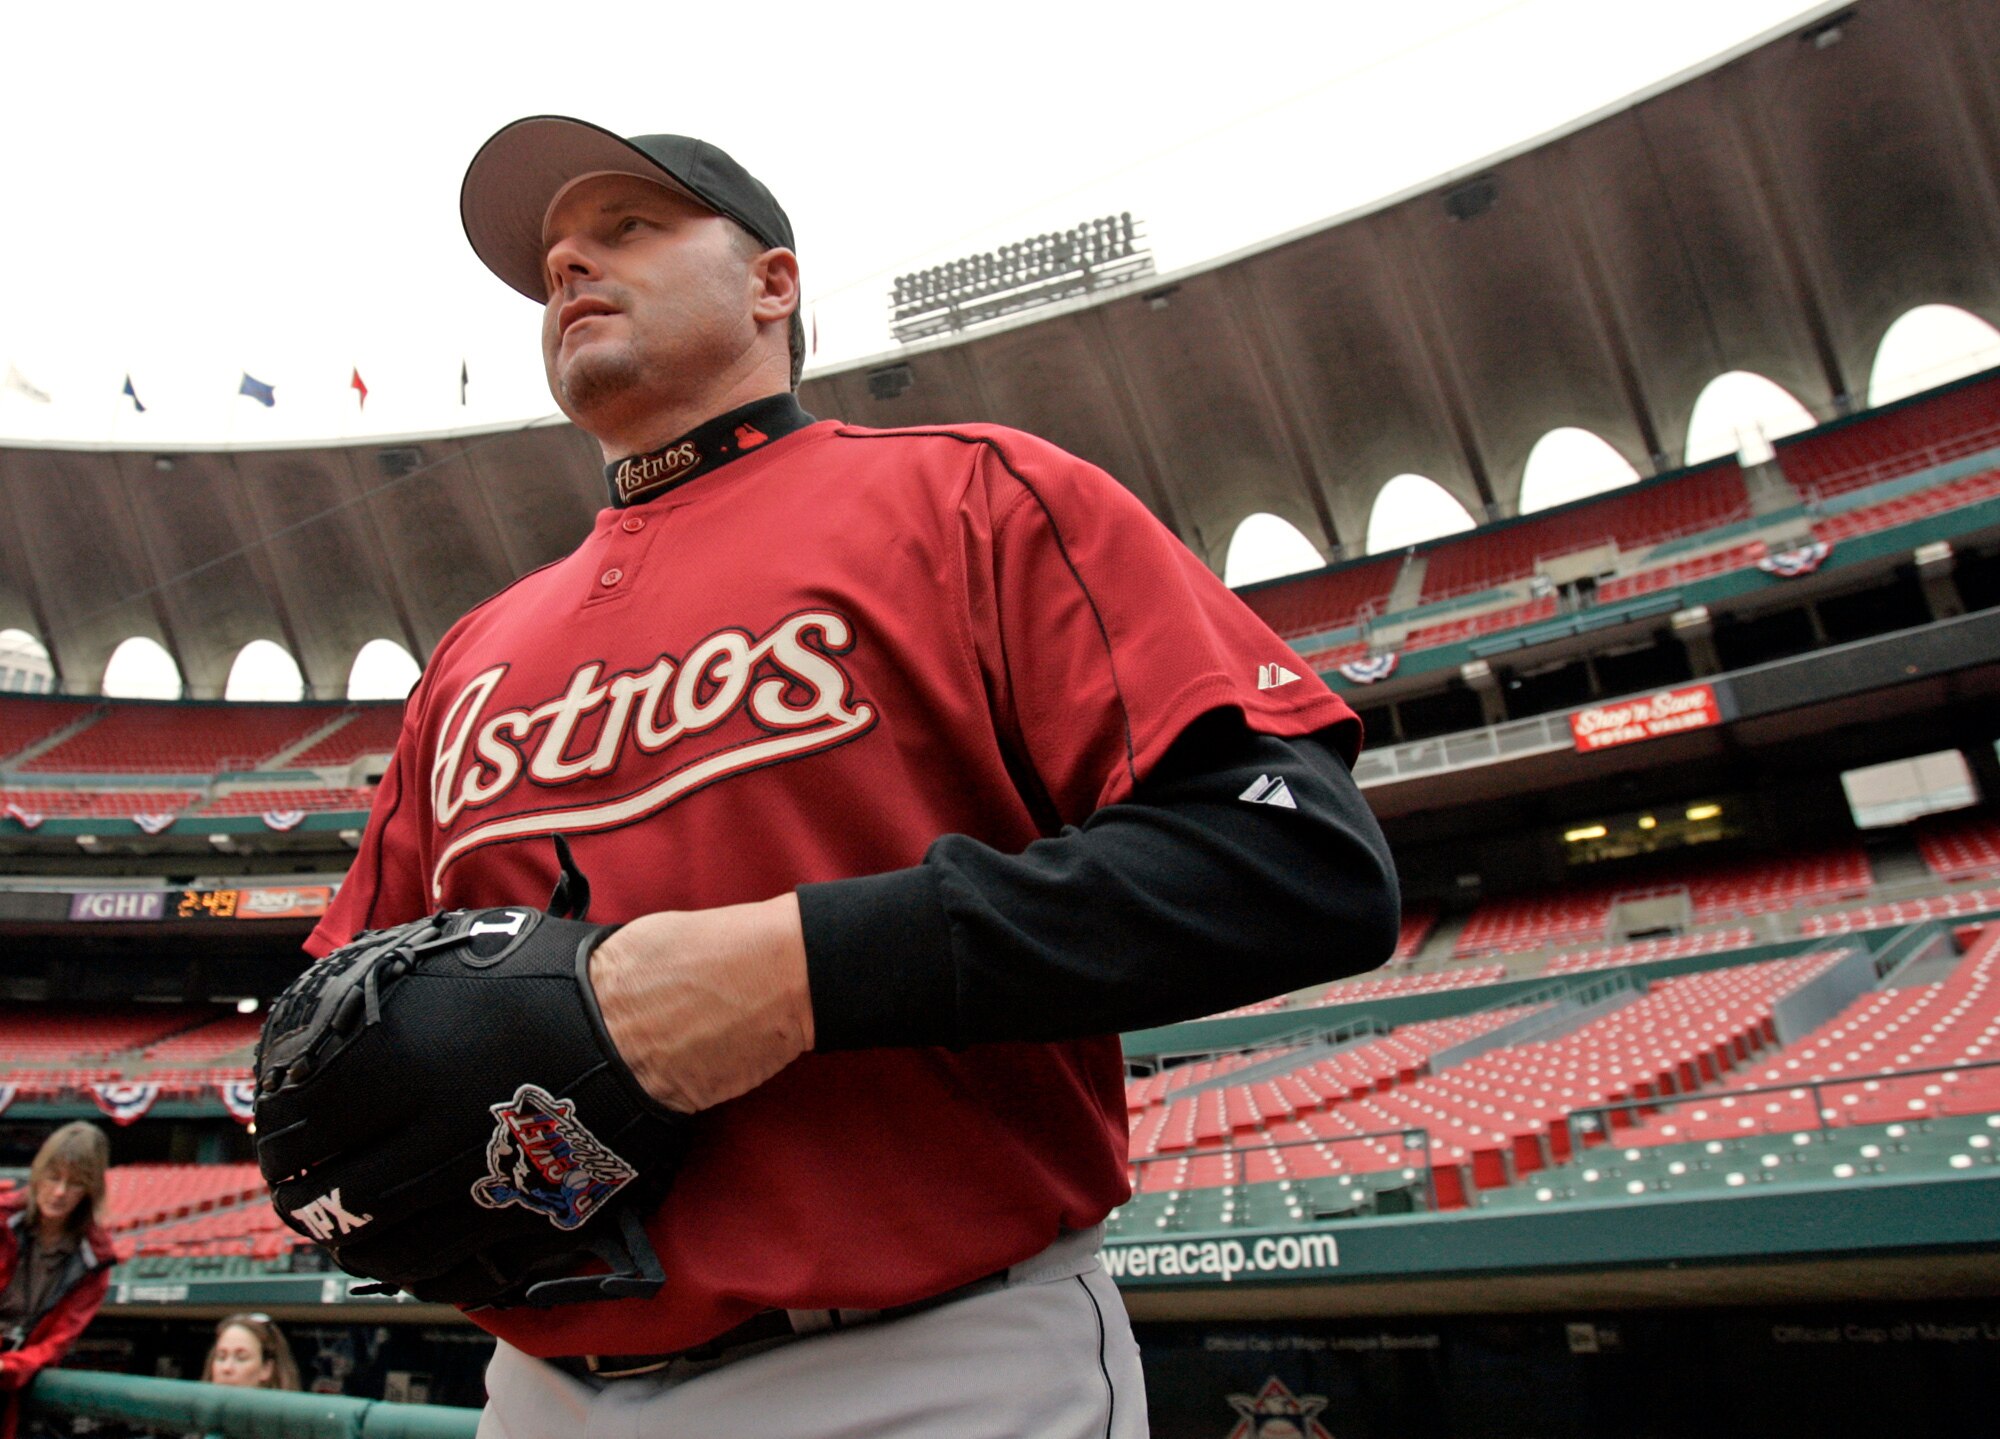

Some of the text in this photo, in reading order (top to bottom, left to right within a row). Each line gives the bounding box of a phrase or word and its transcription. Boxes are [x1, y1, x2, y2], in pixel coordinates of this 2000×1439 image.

[615, 441, 700, 502] Astros
[431, 608, 879, 830] Astros
[290, 1187, 369, 1240] TPX
[1095, 1234, 1339, 1281] weracap.com
